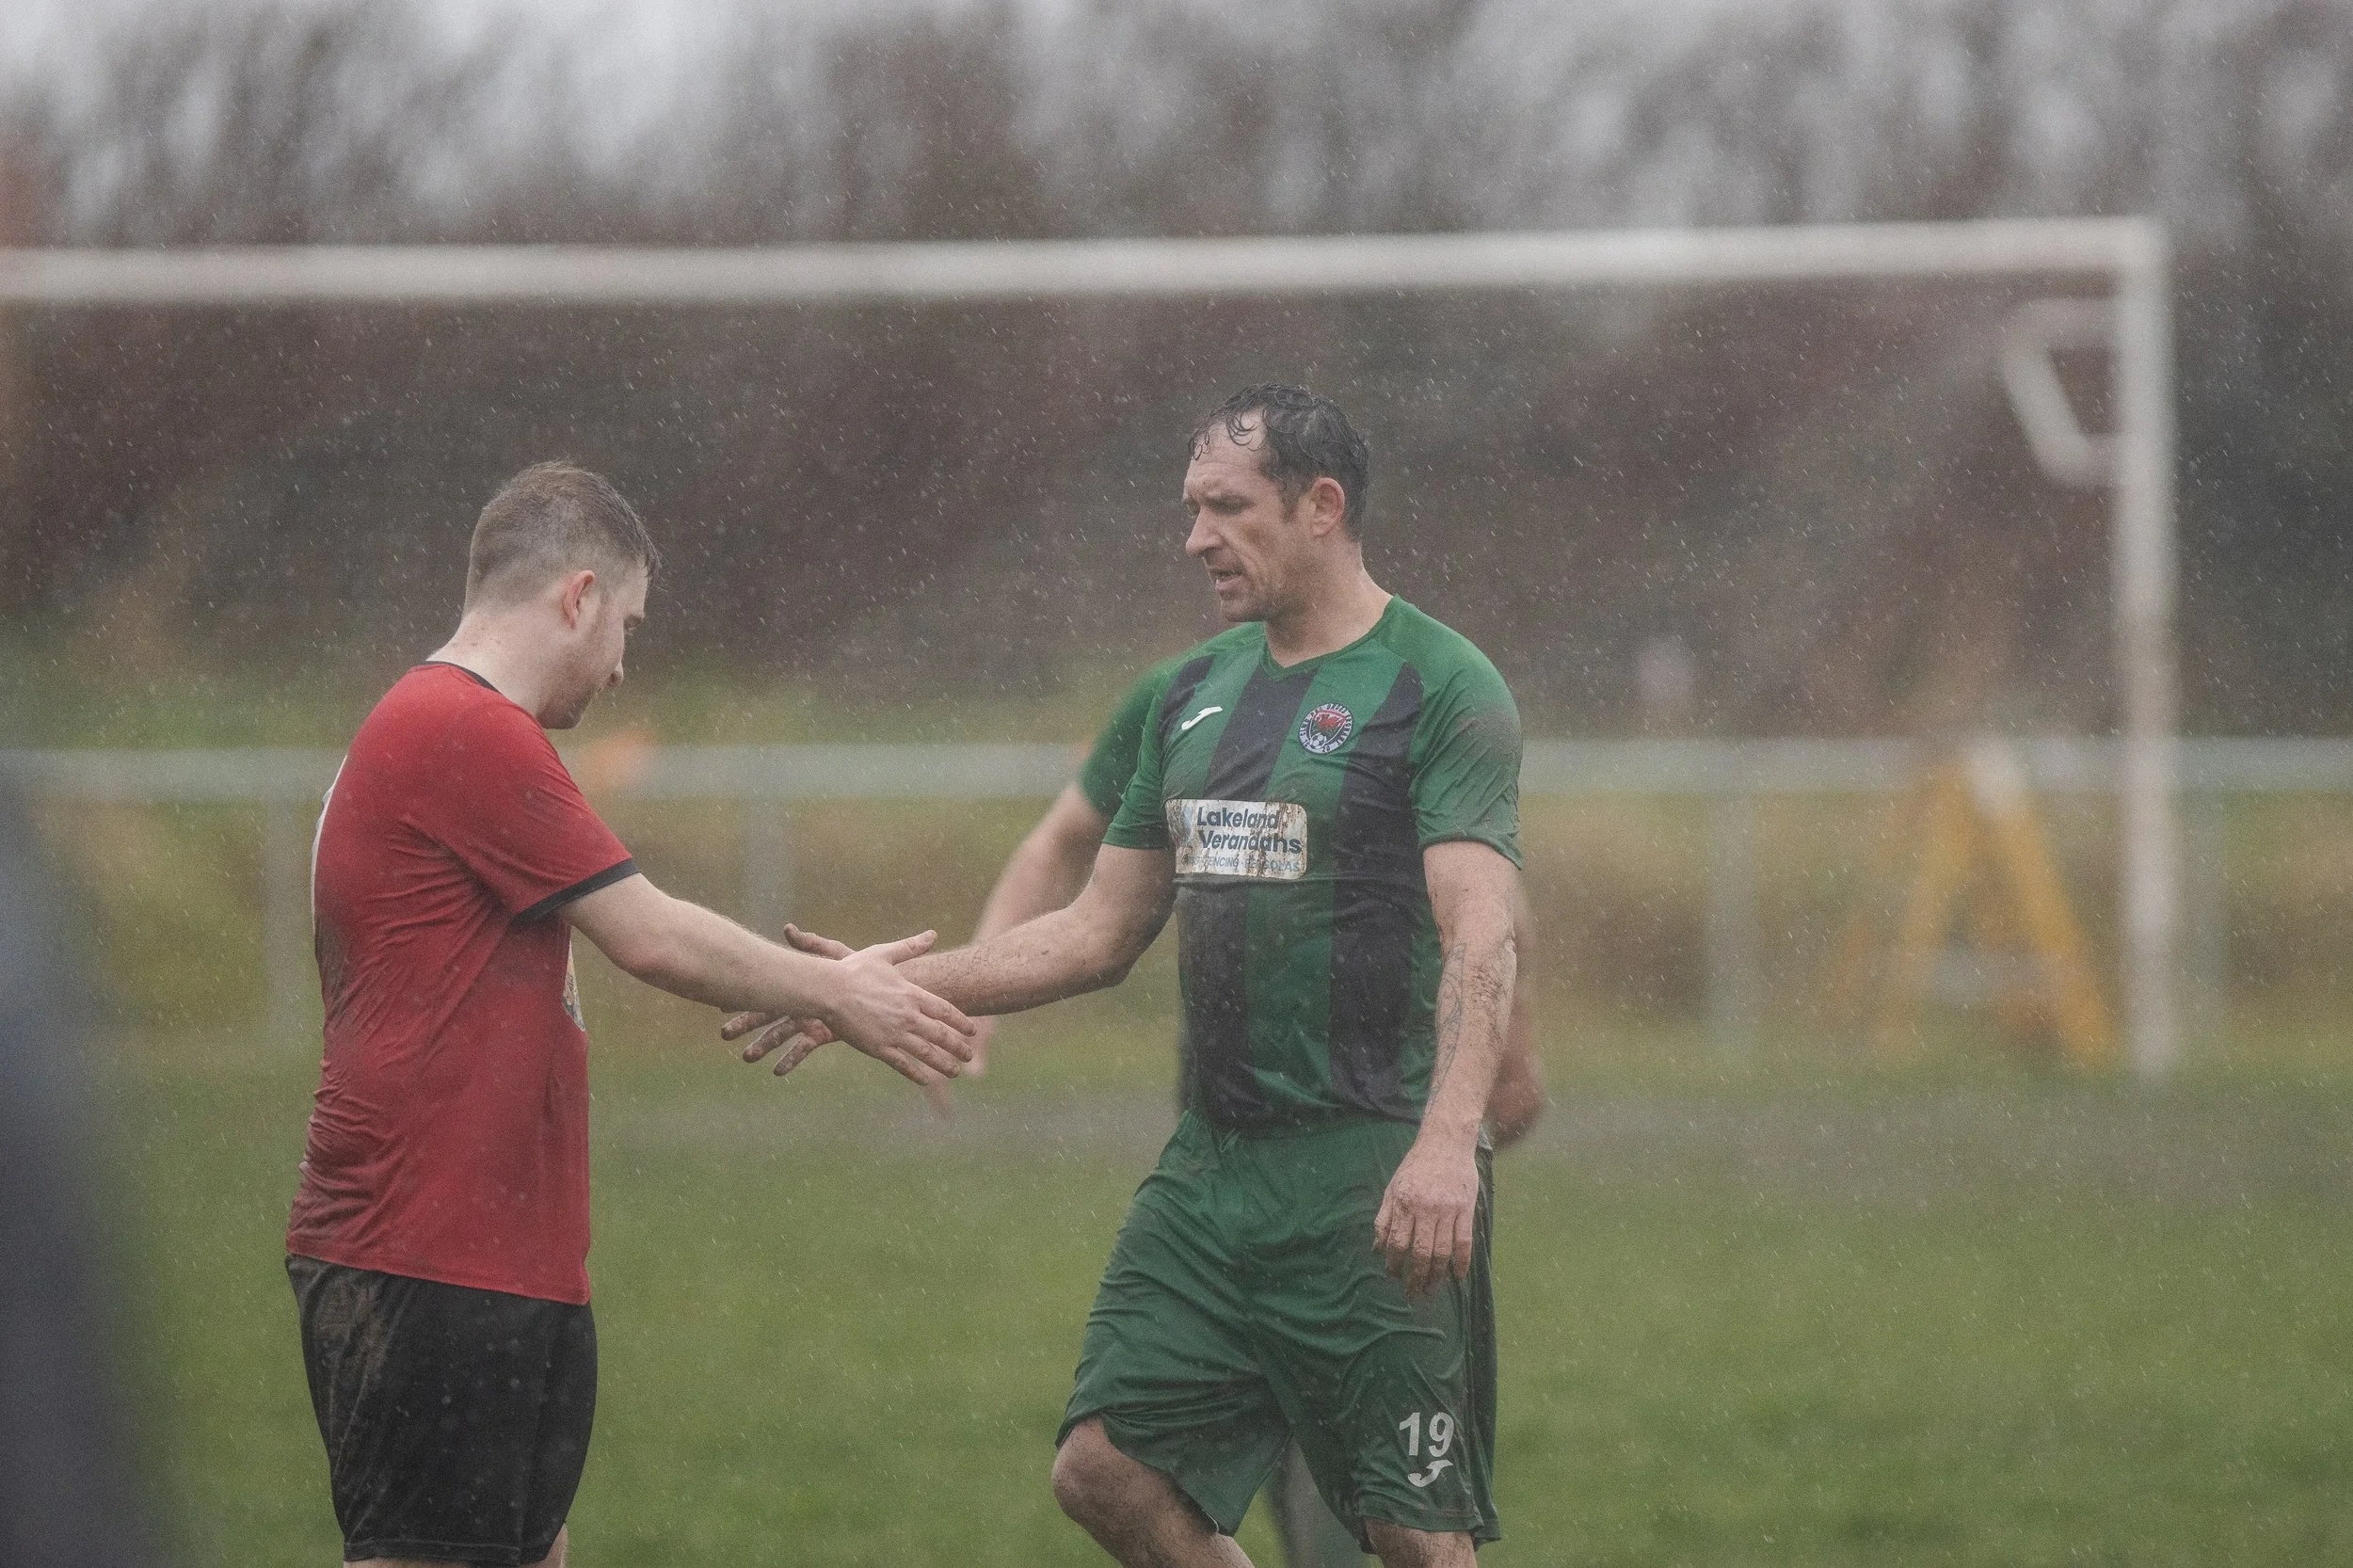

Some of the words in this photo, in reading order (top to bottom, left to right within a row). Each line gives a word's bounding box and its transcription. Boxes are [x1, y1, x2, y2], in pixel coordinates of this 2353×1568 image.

[1196, 807, 1280, 829] Lakeland
[1198, 829, 1303, 855] Verandahs
[1399, 1412, 1455, 1458] 19
